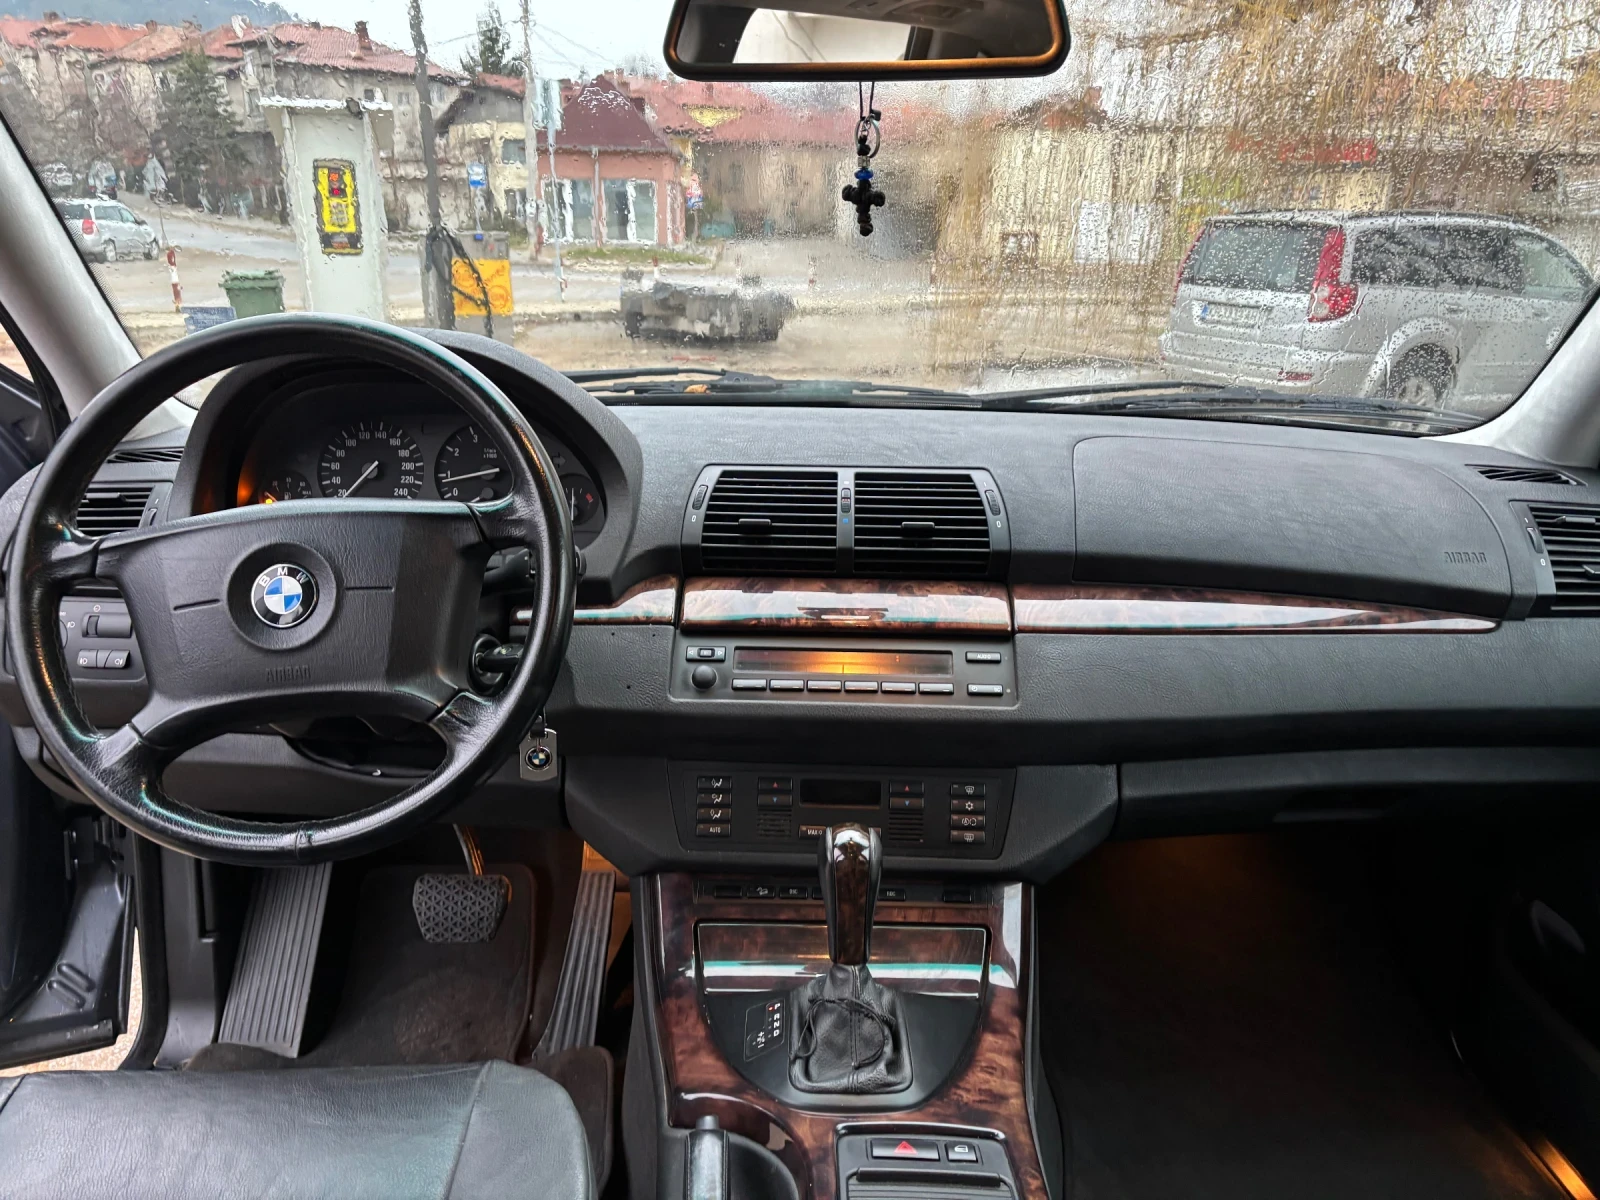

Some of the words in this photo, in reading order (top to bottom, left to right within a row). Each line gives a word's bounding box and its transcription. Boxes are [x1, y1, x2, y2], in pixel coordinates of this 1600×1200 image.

[389, 438, 401, 446] 160
[472, 434, 478, 443] 3
[345, 439, 357, 447] 100
[336, 449, 345, 457] 80
[398, 449, 410, 457] 180
[454, 448, 460, 456] 2
[330, 462, 340, 470] 60
[401, 462, 415, 470] 200
[331, 476, 341, 484] 40
[400, 476, 414, 484] 220
[393, 488, 408, 496] 240
[452, 487, 459, 497] 0
[258, 566, 310, 588] BMW
[774, 1020, 780, 1028] N
